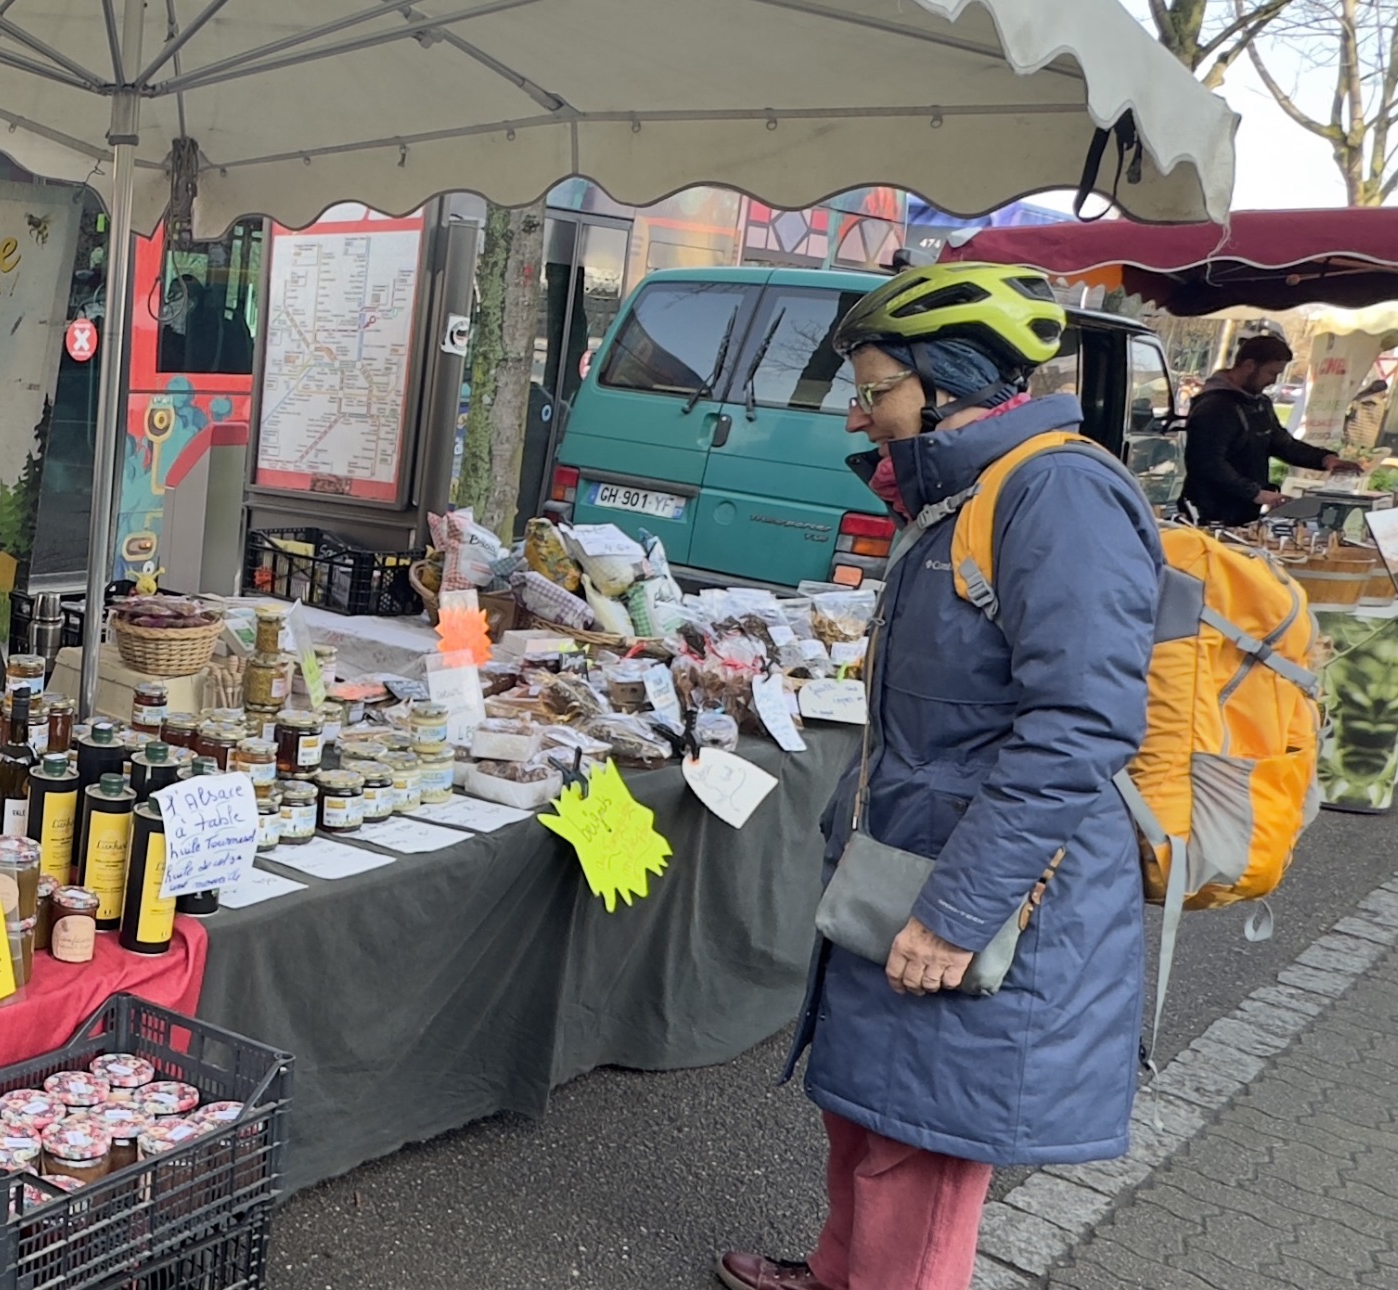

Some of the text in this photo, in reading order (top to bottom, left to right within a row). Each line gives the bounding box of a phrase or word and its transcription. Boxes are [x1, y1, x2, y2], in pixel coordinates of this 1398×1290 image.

[919, 238, 941, 249] 474
[175, 807, 246, 839] à table
